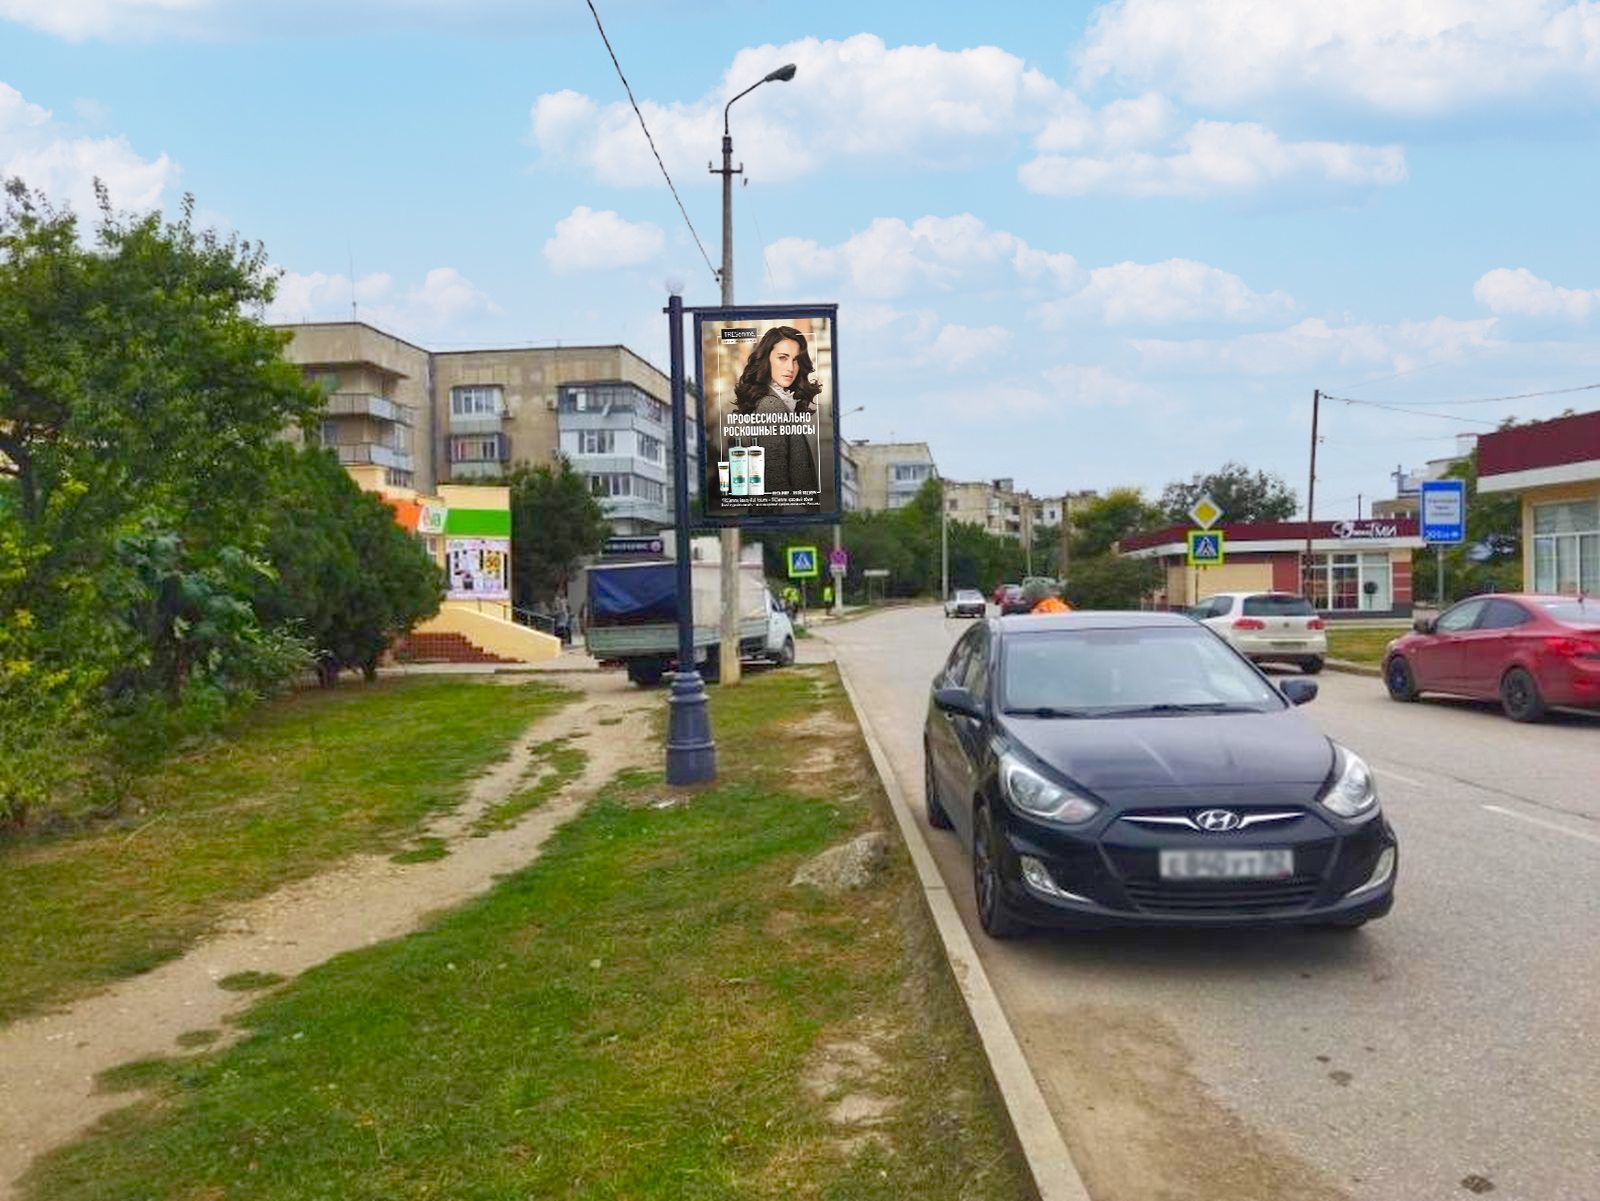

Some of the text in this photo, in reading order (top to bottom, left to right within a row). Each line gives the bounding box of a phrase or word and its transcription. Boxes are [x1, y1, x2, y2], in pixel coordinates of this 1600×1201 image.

[727, 412, 811, 424] ПРОФЕССИОНАЛЬНО
[723, 424, 816, 437] РОСКОШНЫЕ ВОЛОСЫ
